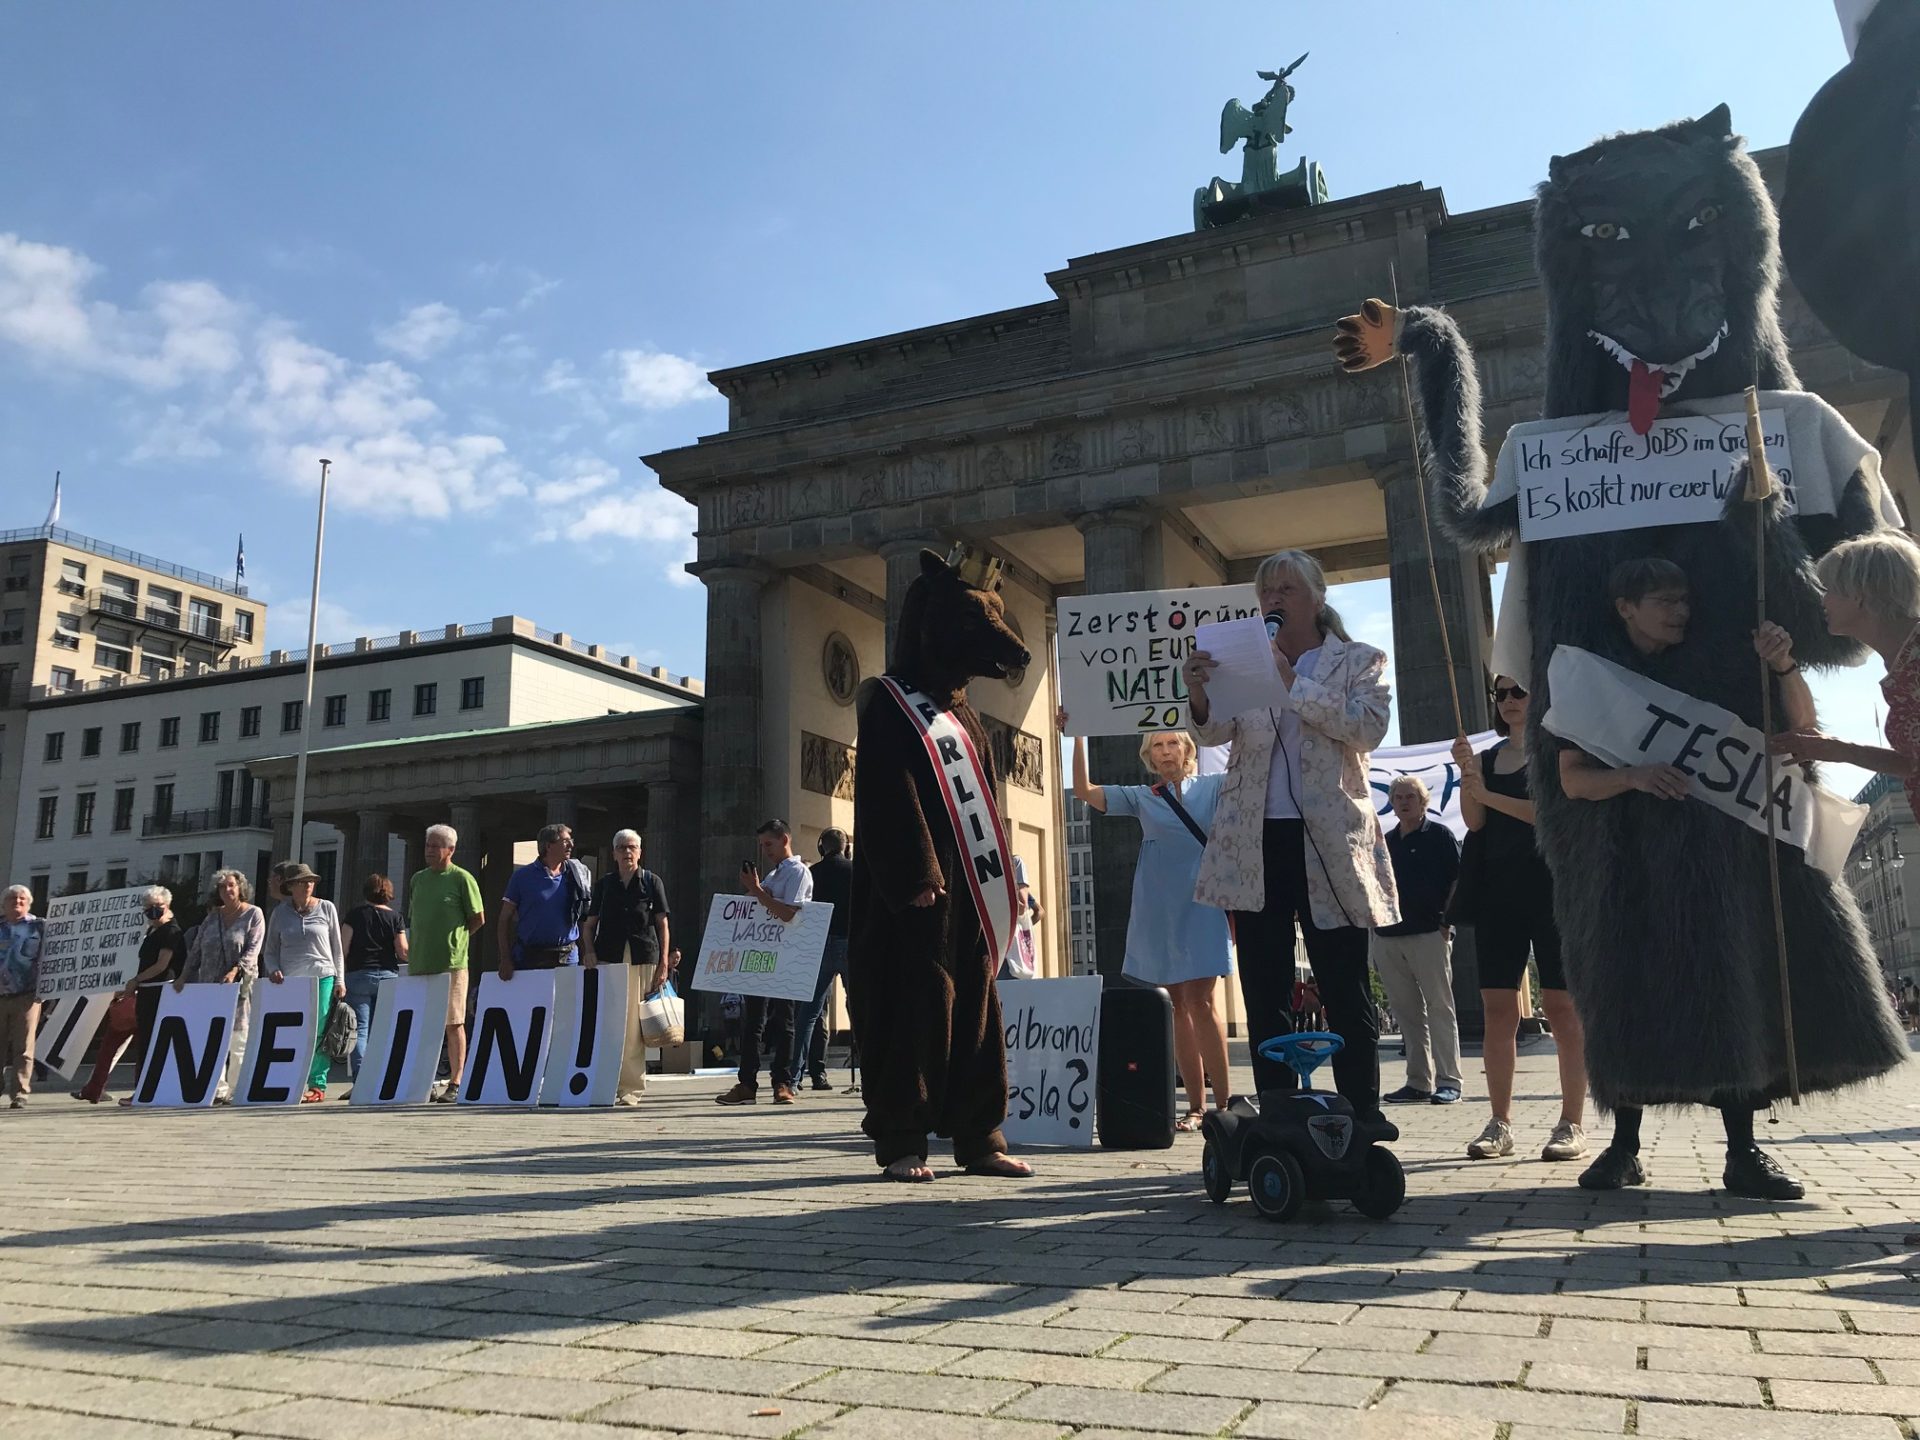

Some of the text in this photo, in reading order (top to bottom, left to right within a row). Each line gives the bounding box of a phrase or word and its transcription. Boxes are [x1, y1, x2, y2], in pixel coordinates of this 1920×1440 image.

[1521, 440, 1551, 472] Ich
[1561, 429, 1635, 466] schaffe
[1693, 434, 1714, 451] im
[1565, 474, 1625, 513] kostet
[1630, 481, 1663, 502] nur
[1668, 479, 1711, 500] euer
[1080, 646, 1137, 667] von
[1638, 702, 1793, 832] TESLA
[50, 903, 67, 918] ERST
[87, 898, 102, 914] DER
[102, 894, 129, 912] LETZTE
[723, 900, 758, 920] OHNE
[80, 917, 92, 934] DER
[94, 914, 122, 931] LETZTE
[122, 912, 145, 929] FLUSS
[732, 921, 785, 943] WASSER
[127, 931, 141, 946] IHR
[81, 954, 100, 970] DASS
[101, 952, 117, 968] MAN
[704, 947, 778, 975] KEIN LEBEN
[57, 975, 78, 992] NICHT
[79, 972, 101, 991] ESSEN
[1000, 1001, 1097, 1055] dbrand
[1007, 1058, 1089, 1129] esla?
